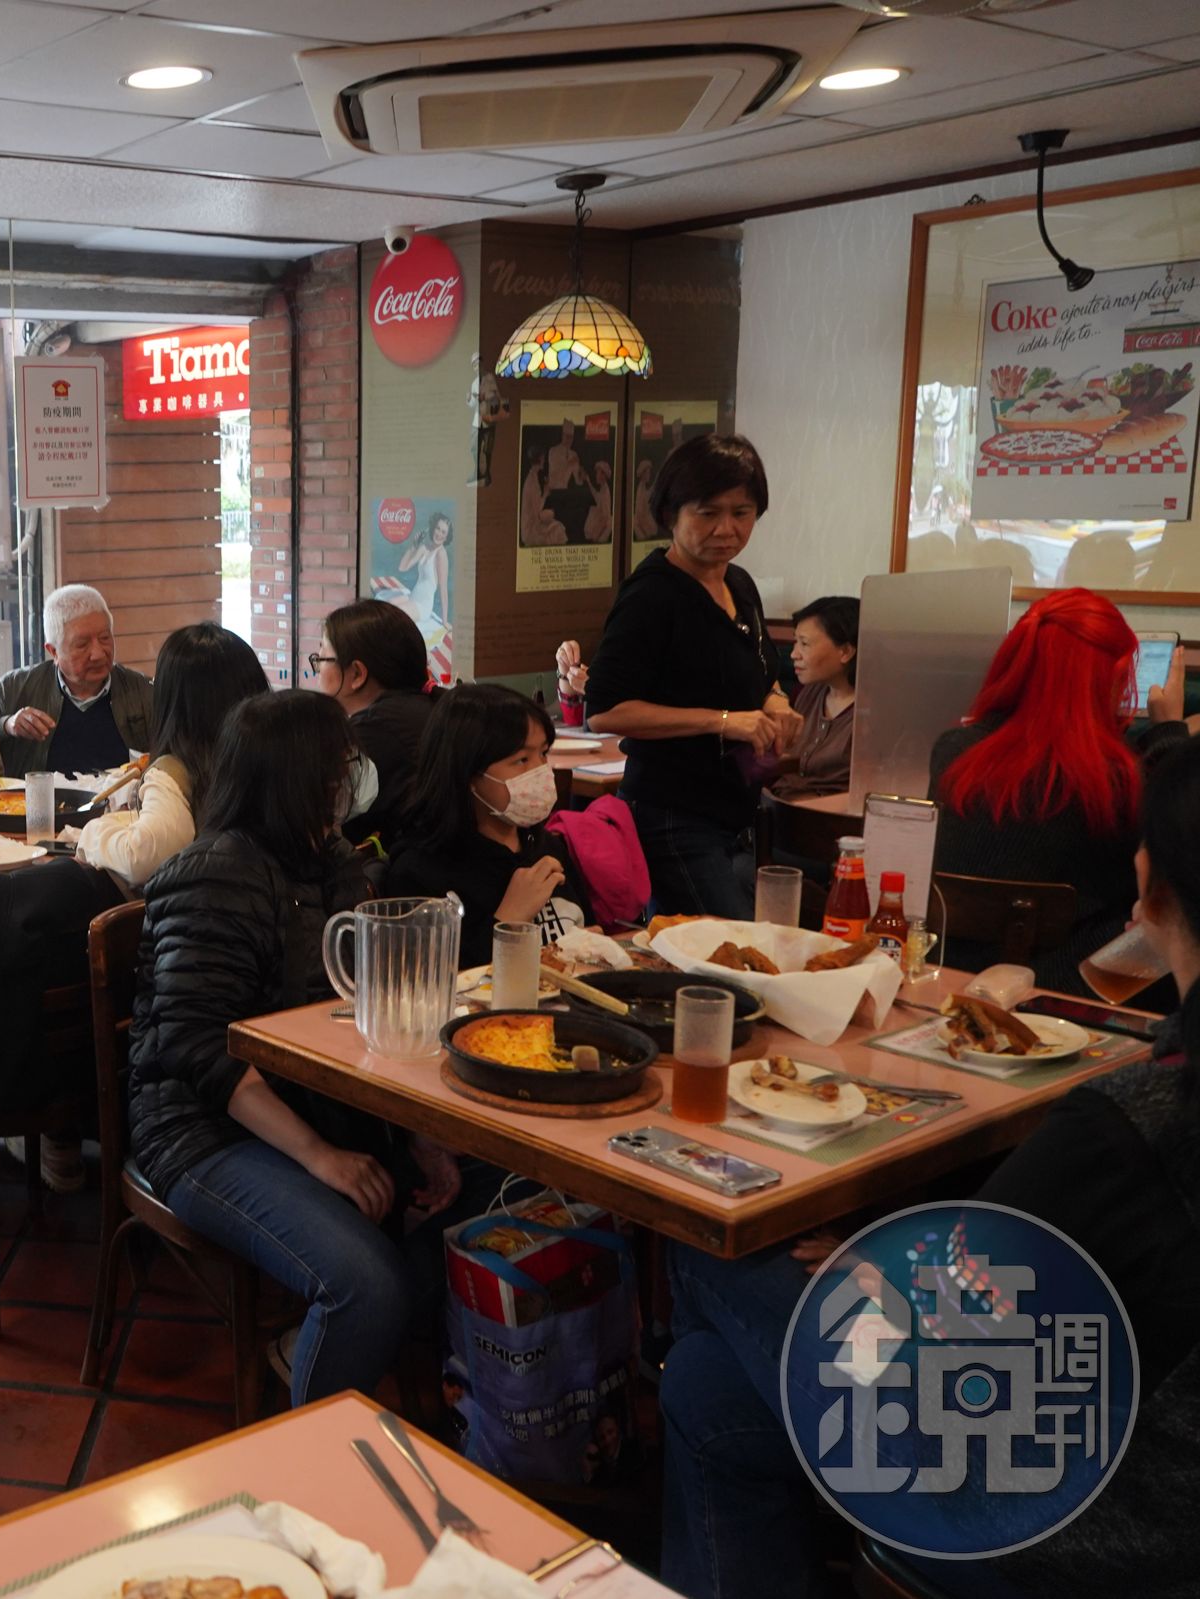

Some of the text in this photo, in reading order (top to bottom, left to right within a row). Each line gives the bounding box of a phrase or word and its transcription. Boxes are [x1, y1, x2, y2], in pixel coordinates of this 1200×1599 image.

[374, 276, 459, 325] Coca-Cola
[990, 300, 1057, 333] Coke
[1113, 293, 1135, 308] nos
[1017, 332, 1050, 355] adds
[1052, 327, 1076, 351] life
[43, 406, 82, 418] 防疫期間
[473, 1335, 547, 1366] SEMICON
